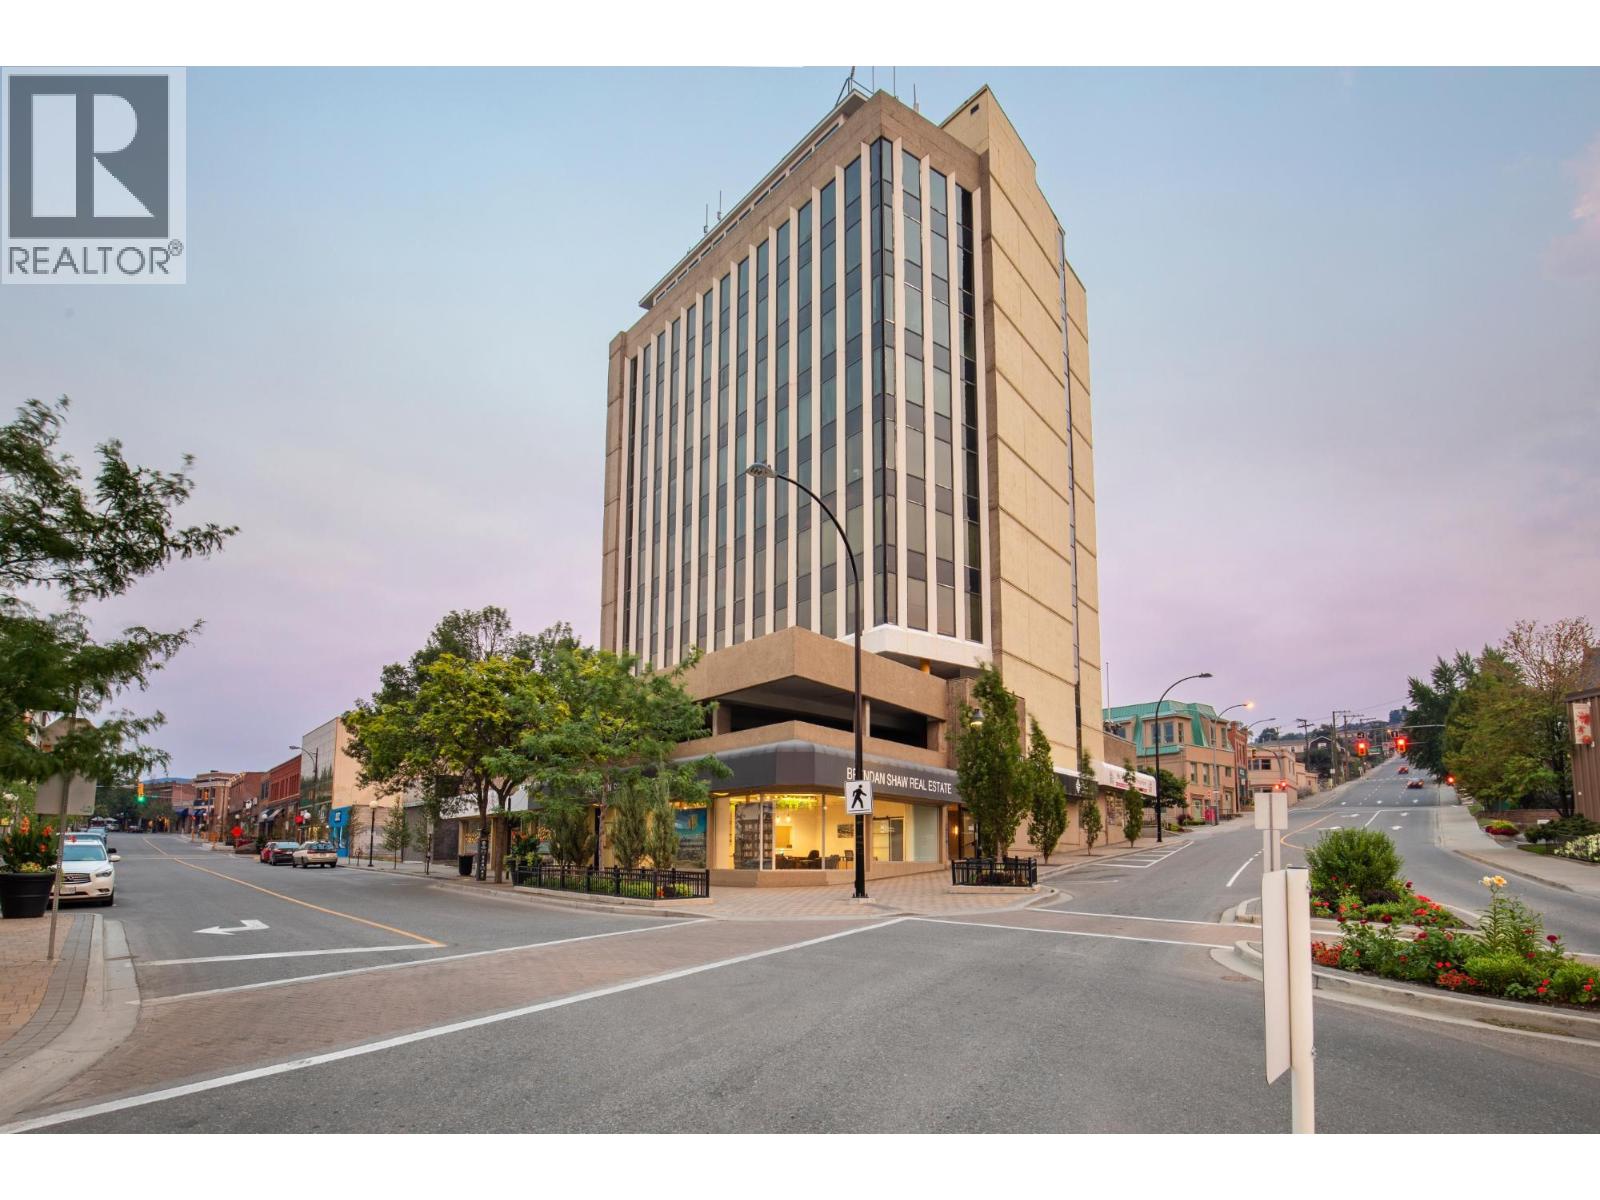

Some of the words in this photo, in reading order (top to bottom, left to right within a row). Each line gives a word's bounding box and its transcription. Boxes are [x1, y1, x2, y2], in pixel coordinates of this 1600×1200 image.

[846, 767, 886, 786] BNDAN
[886, 773, 908, 789] SHAW
[909, 777, 927, 791] REAL
[928, 780, 952, 795] ESTATE
